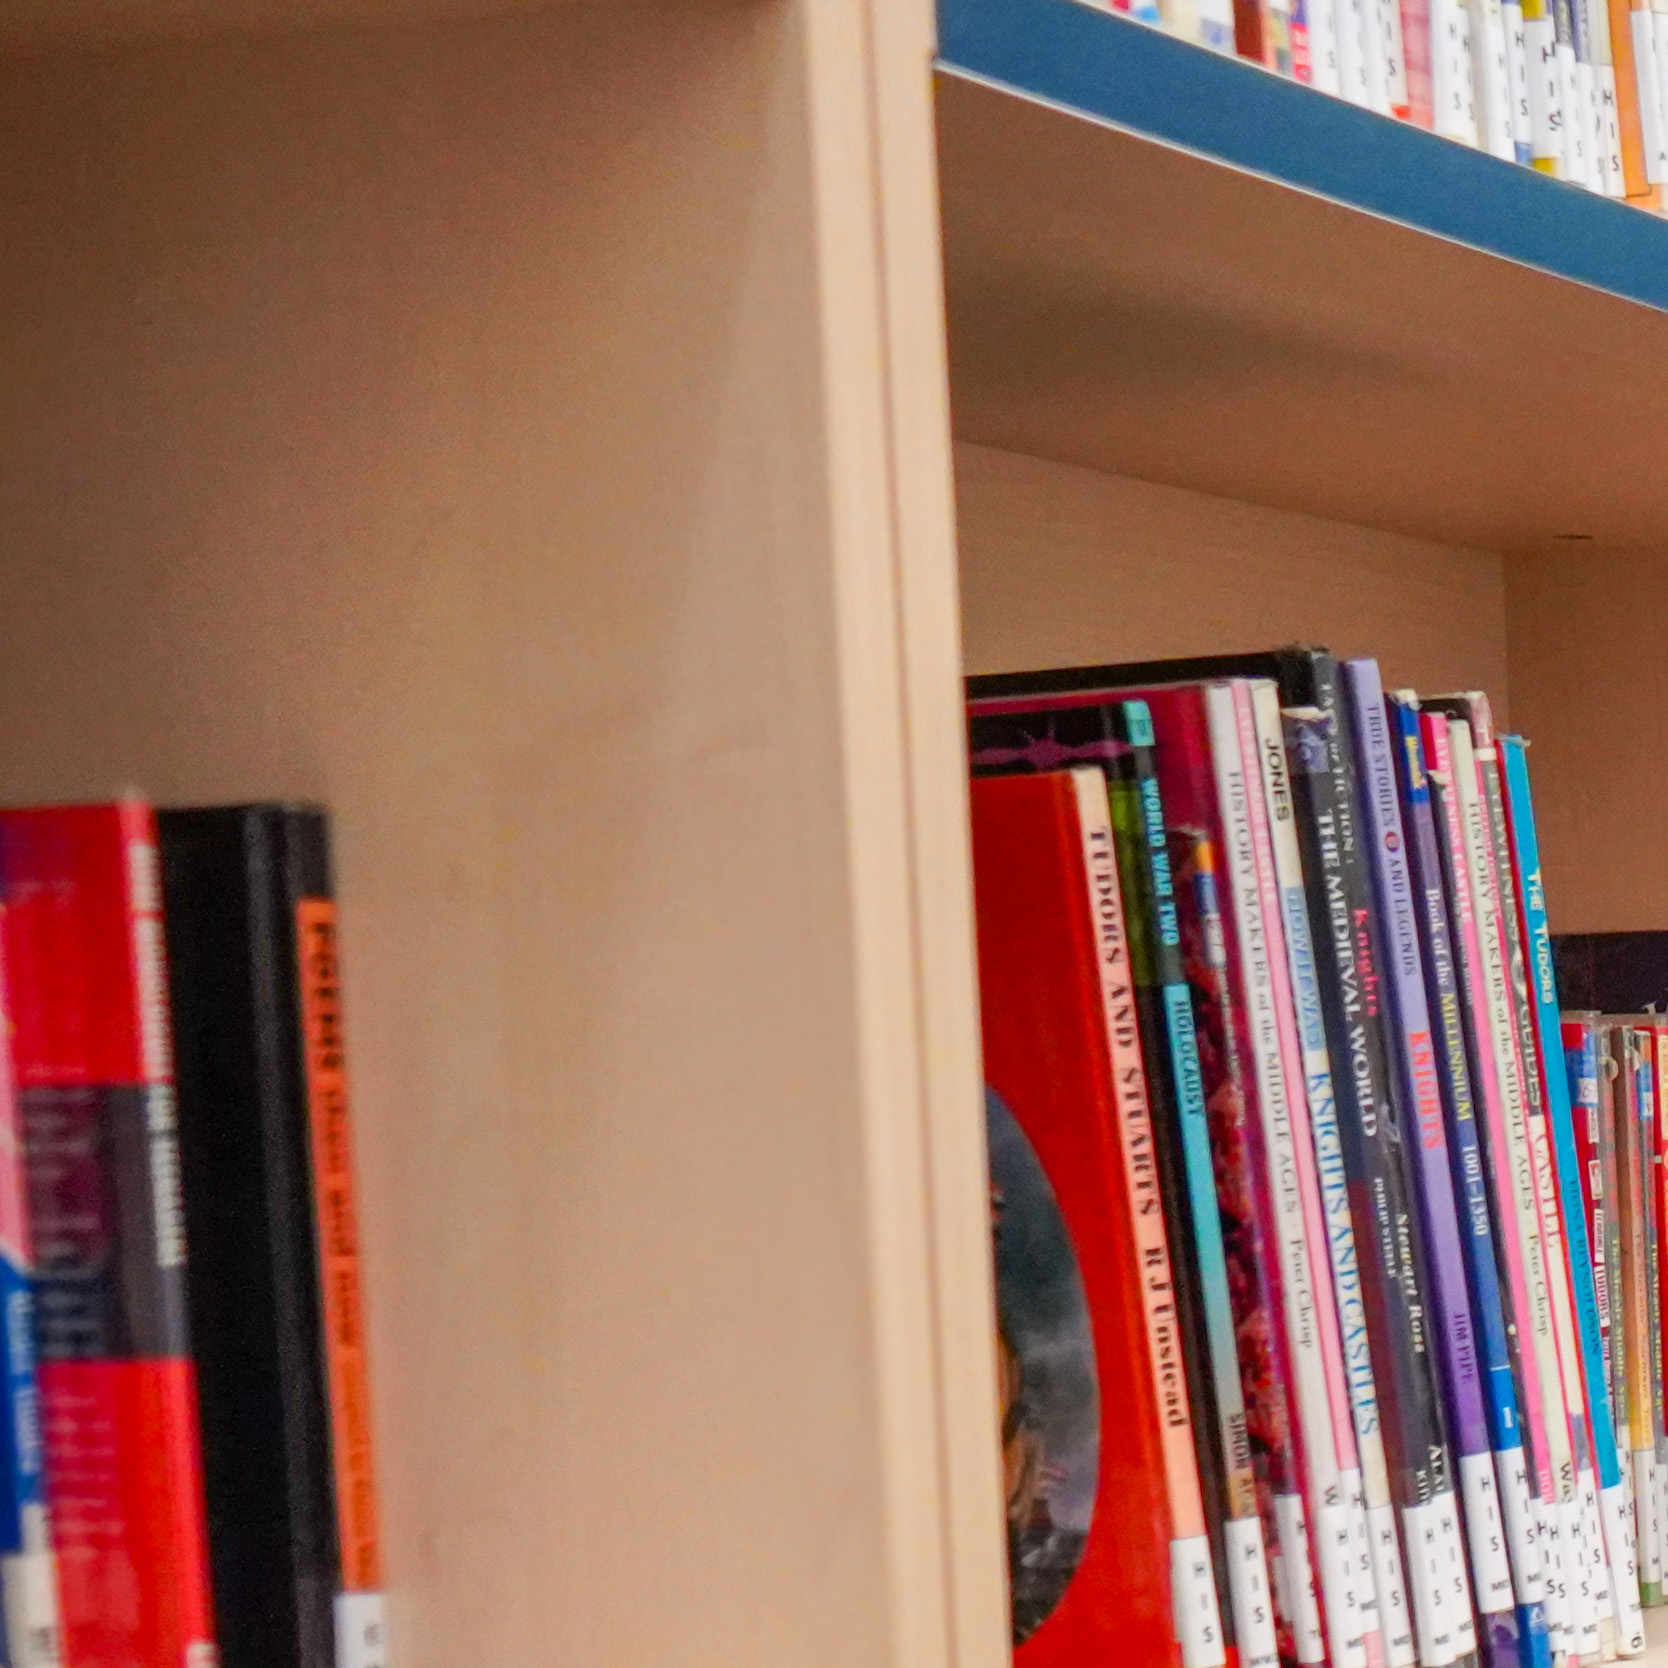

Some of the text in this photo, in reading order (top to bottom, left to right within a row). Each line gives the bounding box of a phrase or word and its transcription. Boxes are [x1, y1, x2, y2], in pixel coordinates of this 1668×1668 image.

[1543, 42, 1562, 131] HIS
[1262, 736, 1293, 822] JONES
[1140, 774, 1181, 946] WORLD WAR TWO
[1361, 702, 1419, 978] TRUE STORIES AND LEGENDS
[1315, 807, 1379, 1137] THE MEDIEVAL WORLD
[1350, 905, 1383, 1018] Knights
[1485, 771, 1544, 1104] EYEWITNESS GUIDES
[1523, 870, 1558, 1005] THE TUDORS
[1086, 823, 1159, 1216] TUDORS AND STUARTS
[1227, 770, 1255, 878] HISTORY
[1243, 885, 1270, 988] MAKERS
[1264, 1050, 1291, 1144] MIDDLE
[1278, 1150, 1299, 1215] AGES
[1423, 886, 1473, 1121] Book of the MILLENNIUM
[1464, 800, 1537, 1212] HISTORY MAKERS the MIDDLE AGES
[1171, 998, 1206, 1118] HOLOCAUST
[1406, 1029, 1446, 1151] KNIGHTS
[1531, 1132, 1563, 1248] CASTLE
[1289, 1237, 1317, 1351] Peter Chrisp
[1307, 1070, 1384, 1434] KNIGHTS AND CASTLES
[1391, 1211, 1429, 1354] Stewart Ross
[1525, 1233, 1554, 1337] Peter Chrisp
[1592, 1266, 1611, 1321] TUDORS
[1152, 1301, 1187, 1426] Unstead
[1449, 1310, 1477, 1386] JIM PIPE
[1441, 1517, 1463, 1593] HIS
[1480, 1475, 1500, 1553] HIS
[1516, 1469, 1536, 1544] HIS
[1618, 1504, 1636, 1578] HIS
[1648, 1468, 1659, 1534] HIS
[1193, 1562, 1213, 1643] HIS
[1245, 1545, 1265, 1624] HIS
[1336, 1529, 1357, 1607] HIS
[1381, 1529, 1402, 1607] HIS
[1425, 1528, 1442, 1606] HIS
[1537, 1521, 1556, 1595] HIS
[1572, 1523, 1590, 1598] HIS
